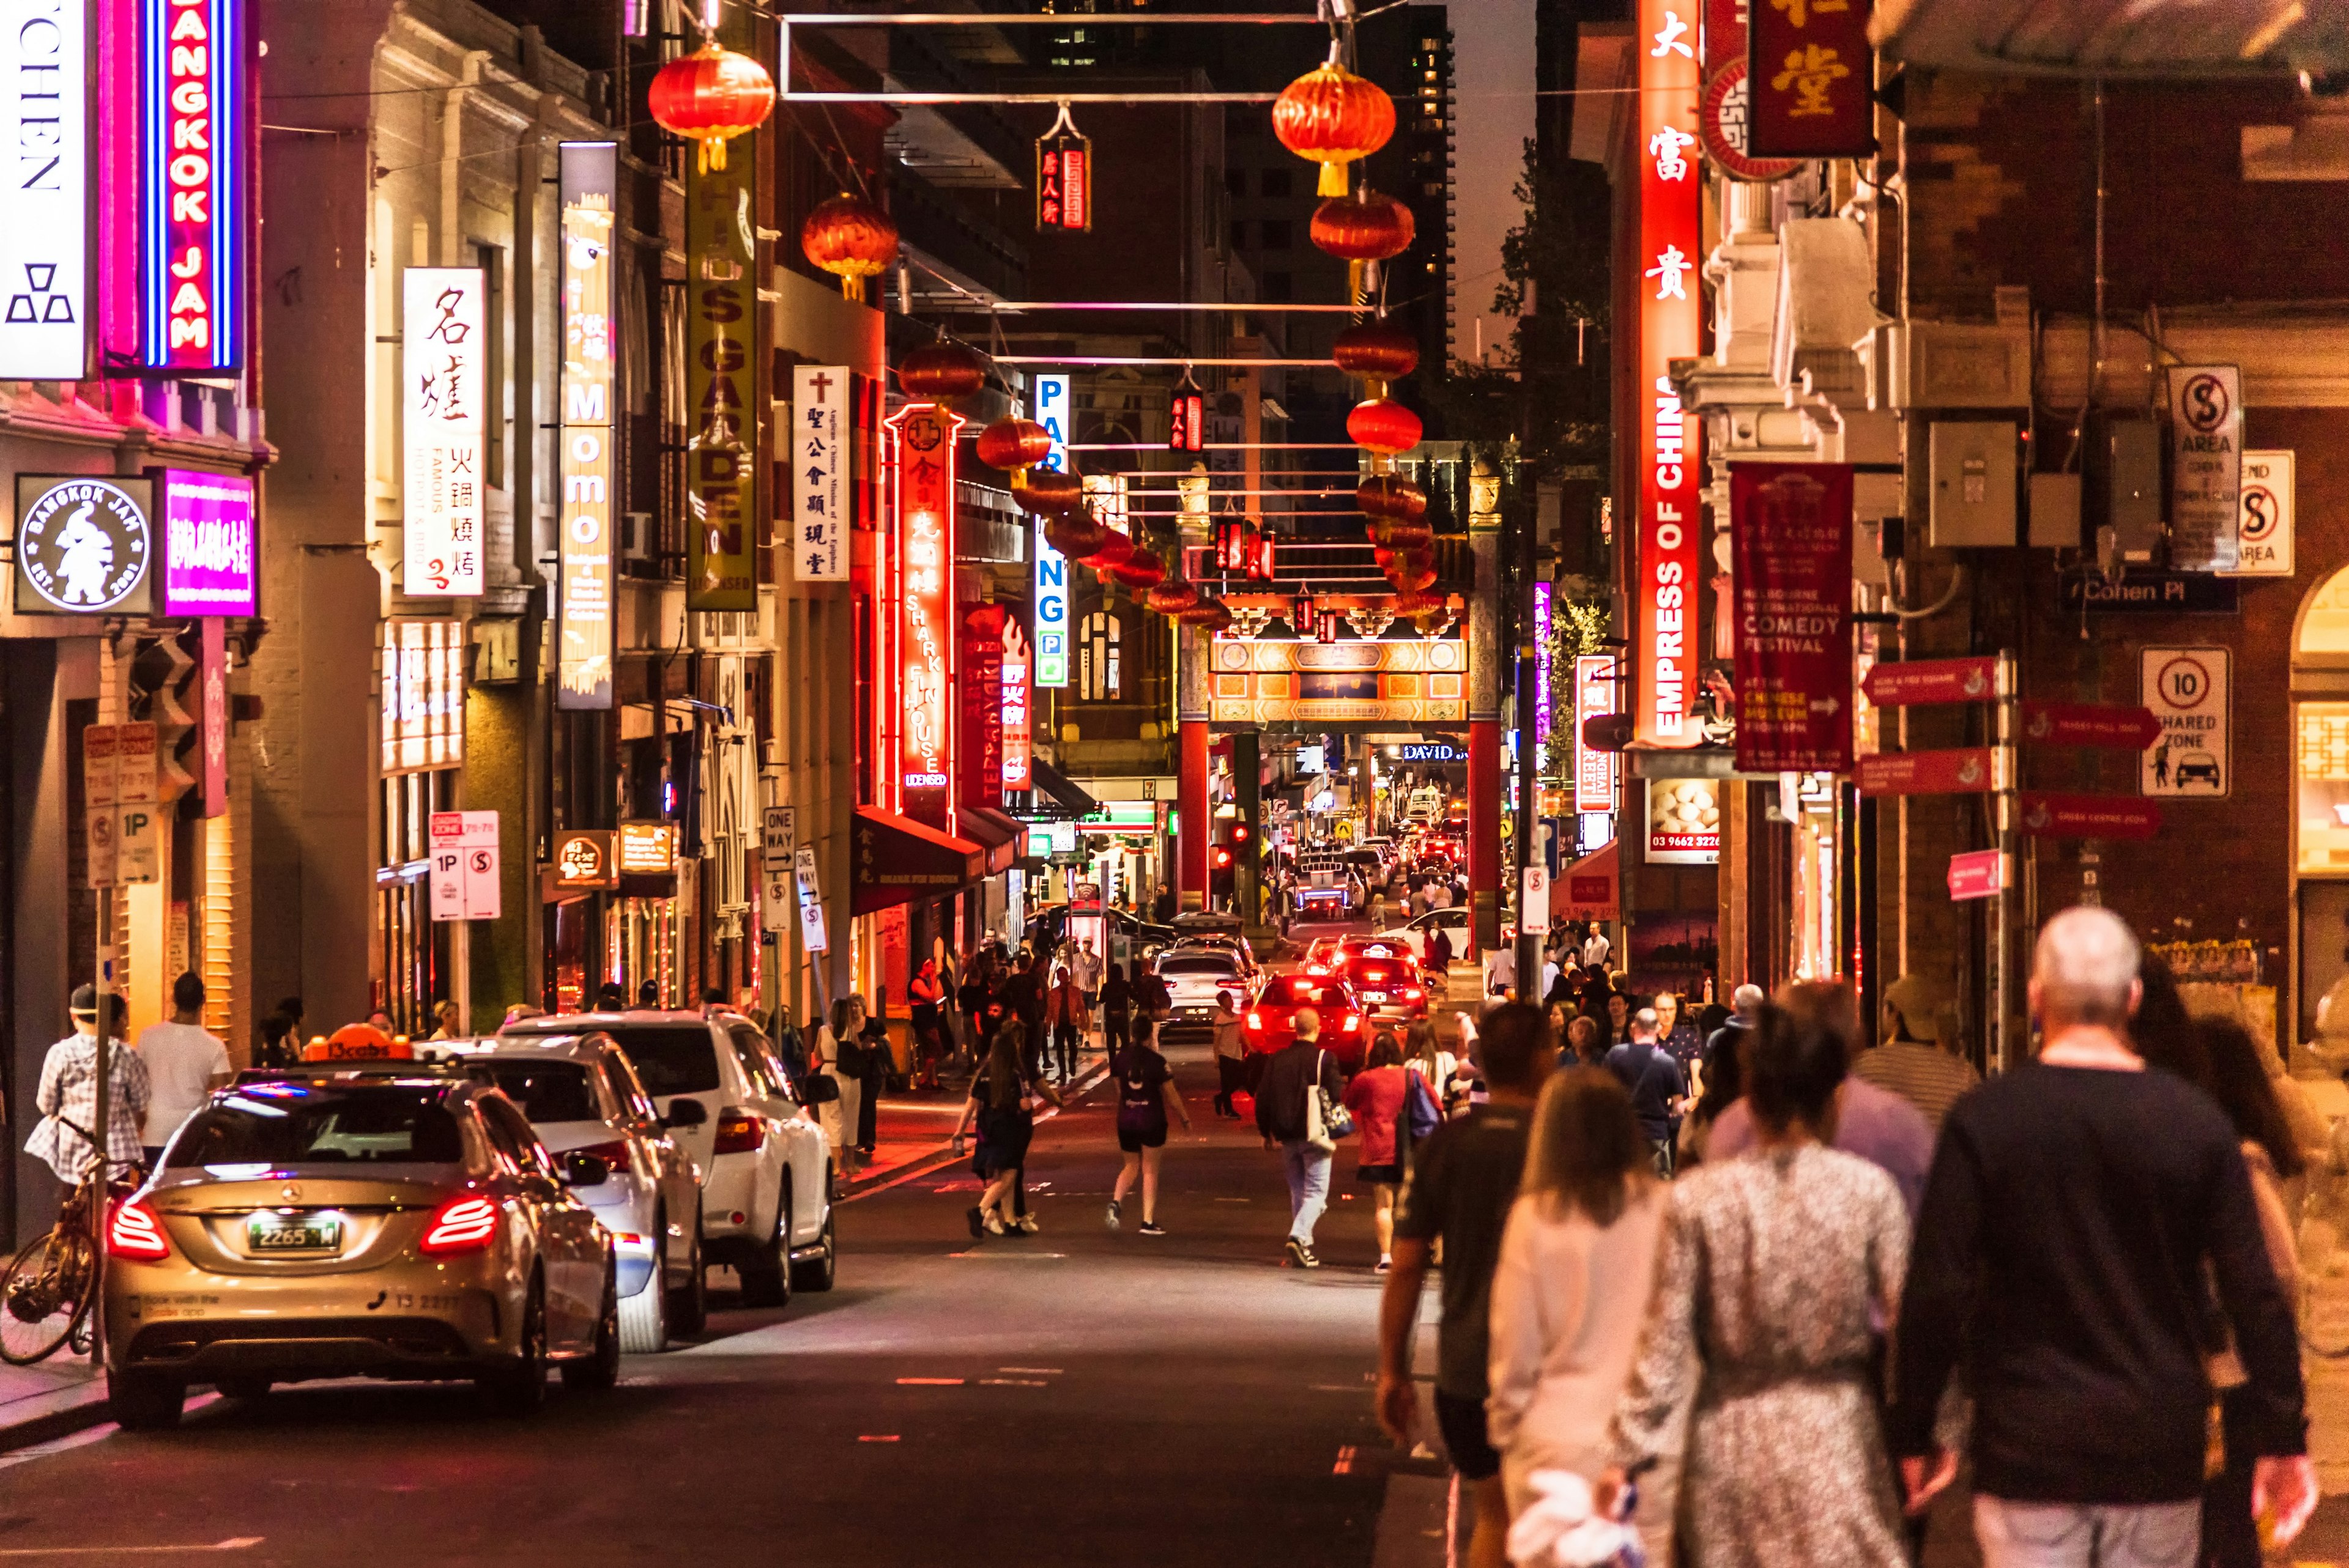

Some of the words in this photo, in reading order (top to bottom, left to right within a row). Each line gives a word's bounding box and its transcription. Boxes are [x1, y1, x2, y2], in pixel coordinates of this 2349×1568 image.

[20, 0, 61, 190] CHEN
[169, 0, 209, 223] ANGKOK
[170, 246, 209, 349] JAM
[829, 408, 837, 441] Anglican
[414, 448, 425, 510] HOTPOT
[432, 448, 443, 514] FAMOUS
[566, 384, 605, 544] Momo
[805, 407, 828, 575] 聖公會顯現堂
[1039, 380, 1063, 623] PARNG
[28, 485, 105, 534] BANGKOK
[108, 497, 140, 532] JAM
[451, 448, 473, 575] 火鍋燒烤
[830, 510, 837, 519] of
[1657, 501, 1682, 549] OF
[415, 531, 425, 564] BBQ
[829, 539, 837, 574] Epiphany
[31, 561, 54, 593] EST.
[109, 562, 139, 596] 2001
[905, 594, 941, 672] SHARK
[1743, 615, 1839, 635] COMEDY
[1656, 563, 1683, 736] EMPRESS
[909, 665, 937, 704] FIN
[2174, 673, 2197, 695] 10
[905, 694, 939, 774] HOUSE
[984, 659, 1000, 799] TEPPANYAKI
[2162, 715, 2216, 730] HARED
[1405, 745, 1453, 760] DAVID
[2165, 735, 2203, 749] ZONE
[124, 813, 148, 837] 1P
[768, 813, 792, 829] ONE
[767, 832, 793, 848] WAY
[1652, 837, 1666, 846] 03
[1668, 837, 1694, 847] 9662
[437, 855, 457, 871] 1P
[796, 854, 812, 868] ONE
[798, 871, 815, 884] WAY
[260, 1229, 306, 1246] 2265
